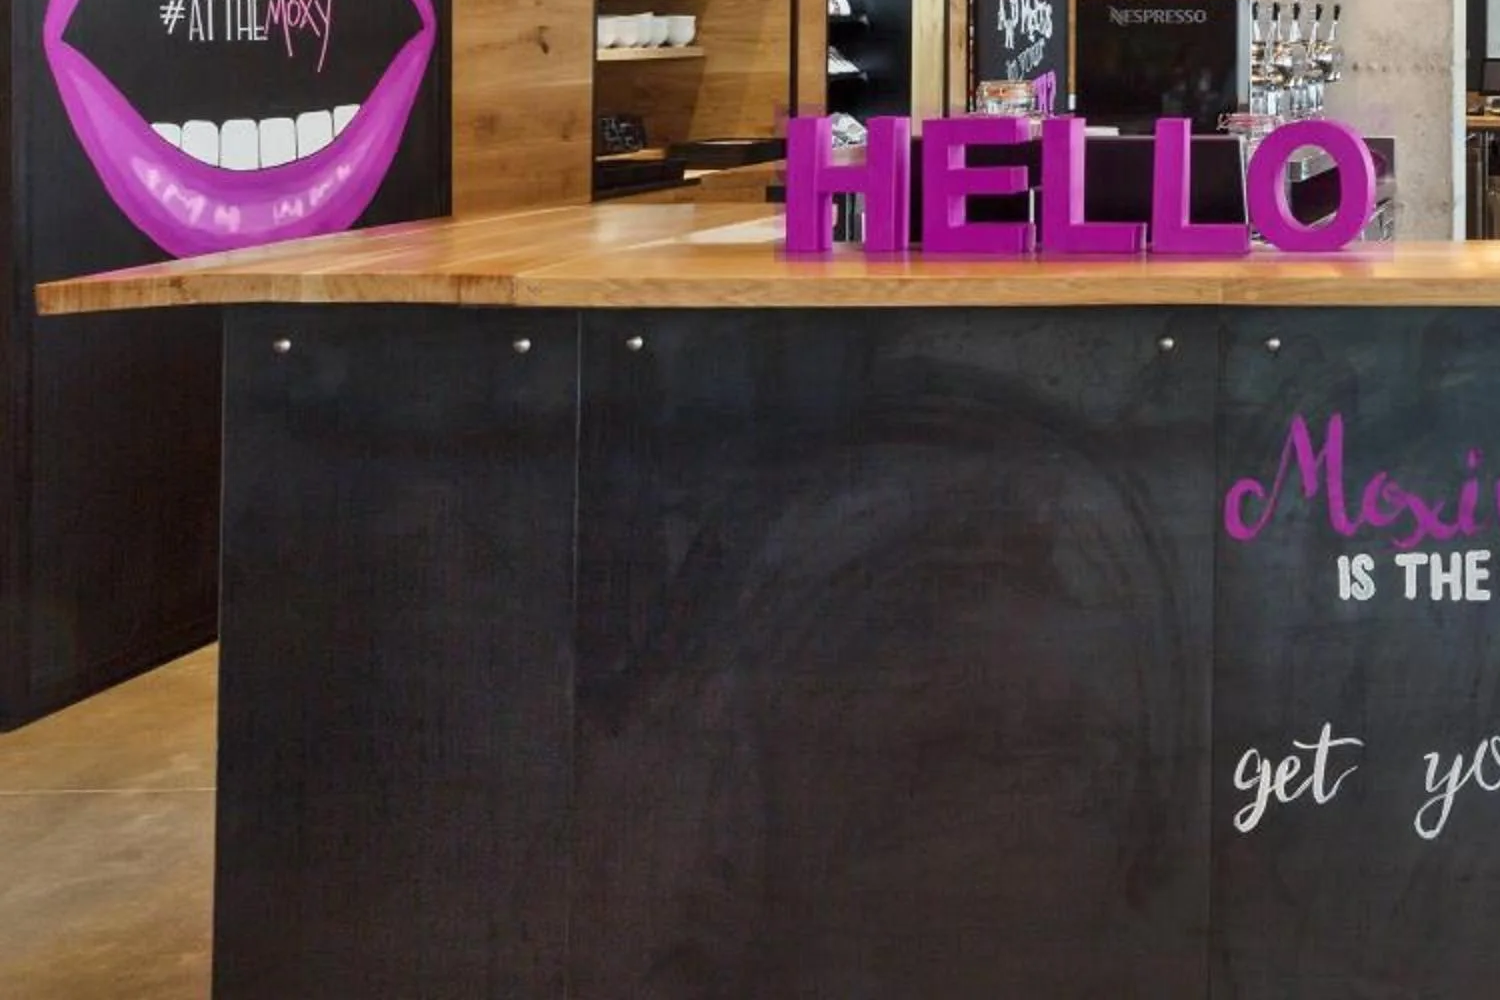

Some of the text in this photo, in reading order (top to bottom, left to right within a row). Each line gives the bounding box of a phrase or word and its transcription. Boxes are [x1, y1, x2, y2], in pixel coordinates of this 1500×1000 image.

[1108, 5, 1207, 26] NESPRESSO
[786, 116, 1376, 254] HELLO
[1337, 553, 1376, 601] IS
[1394, 549, 1491, 602] THE
[1232, 721, 1366, 834] get
